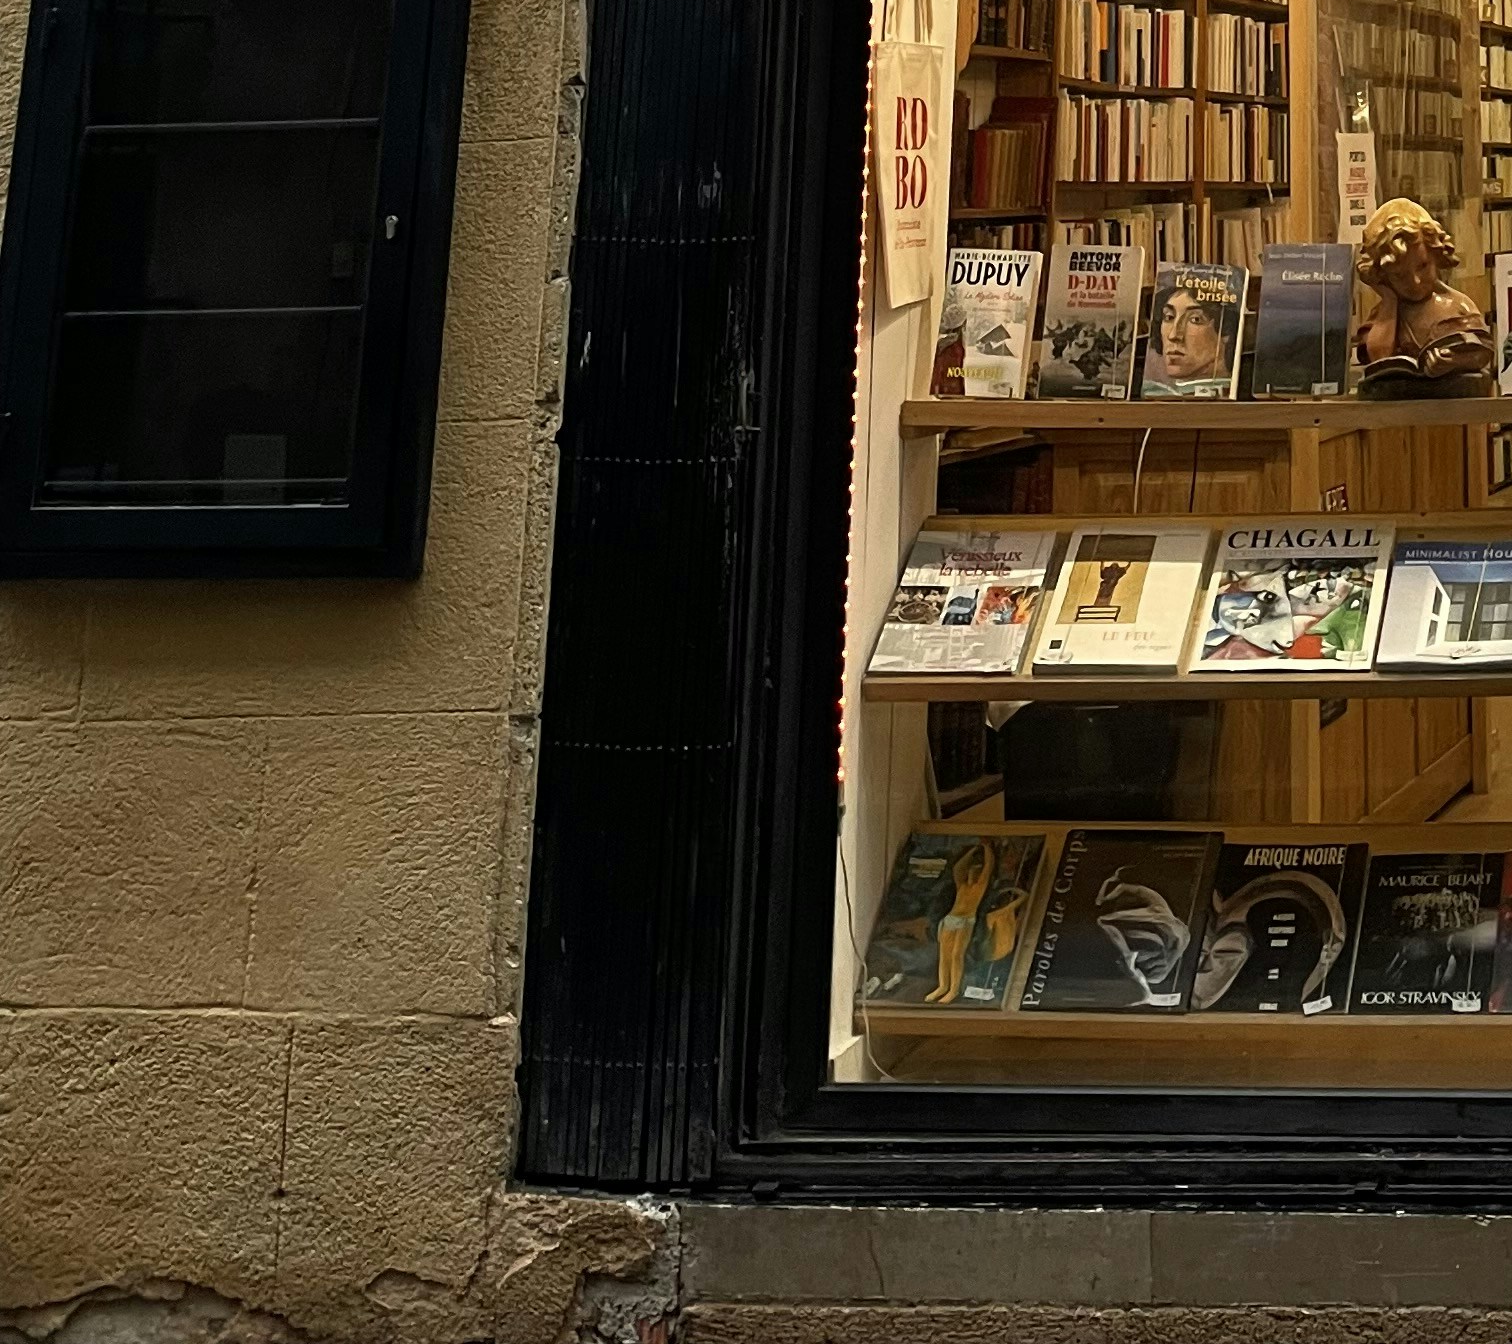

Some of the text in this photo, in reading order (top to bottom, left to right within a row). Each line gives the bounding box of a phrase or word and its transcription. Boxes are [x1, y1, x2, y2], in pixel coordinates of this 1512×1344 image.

[894, 96, 929, 151] RD
[894, 154, 928, 211] BO
[1070, 251, 1122, 262] ANTONY
[950, 261, 1030, 288] DUPUY
[1068, 261, 1122, 273] BEEVOR
[1067, 274, 1120, 291] D-DAY
[1227, 528, 1381, 550] CHAGALL
[1405, 549, 1478, 560] MINIMALIST
[1243, 846, 1347, 870] AFRIQUE NOIRE
[1378, 874, 1441, 887] MAURICE
[1021, 829, 1089, 1007] Paroles de Corps
[1360, 990, 1482, 1005] IGOR STRAVINSKY
